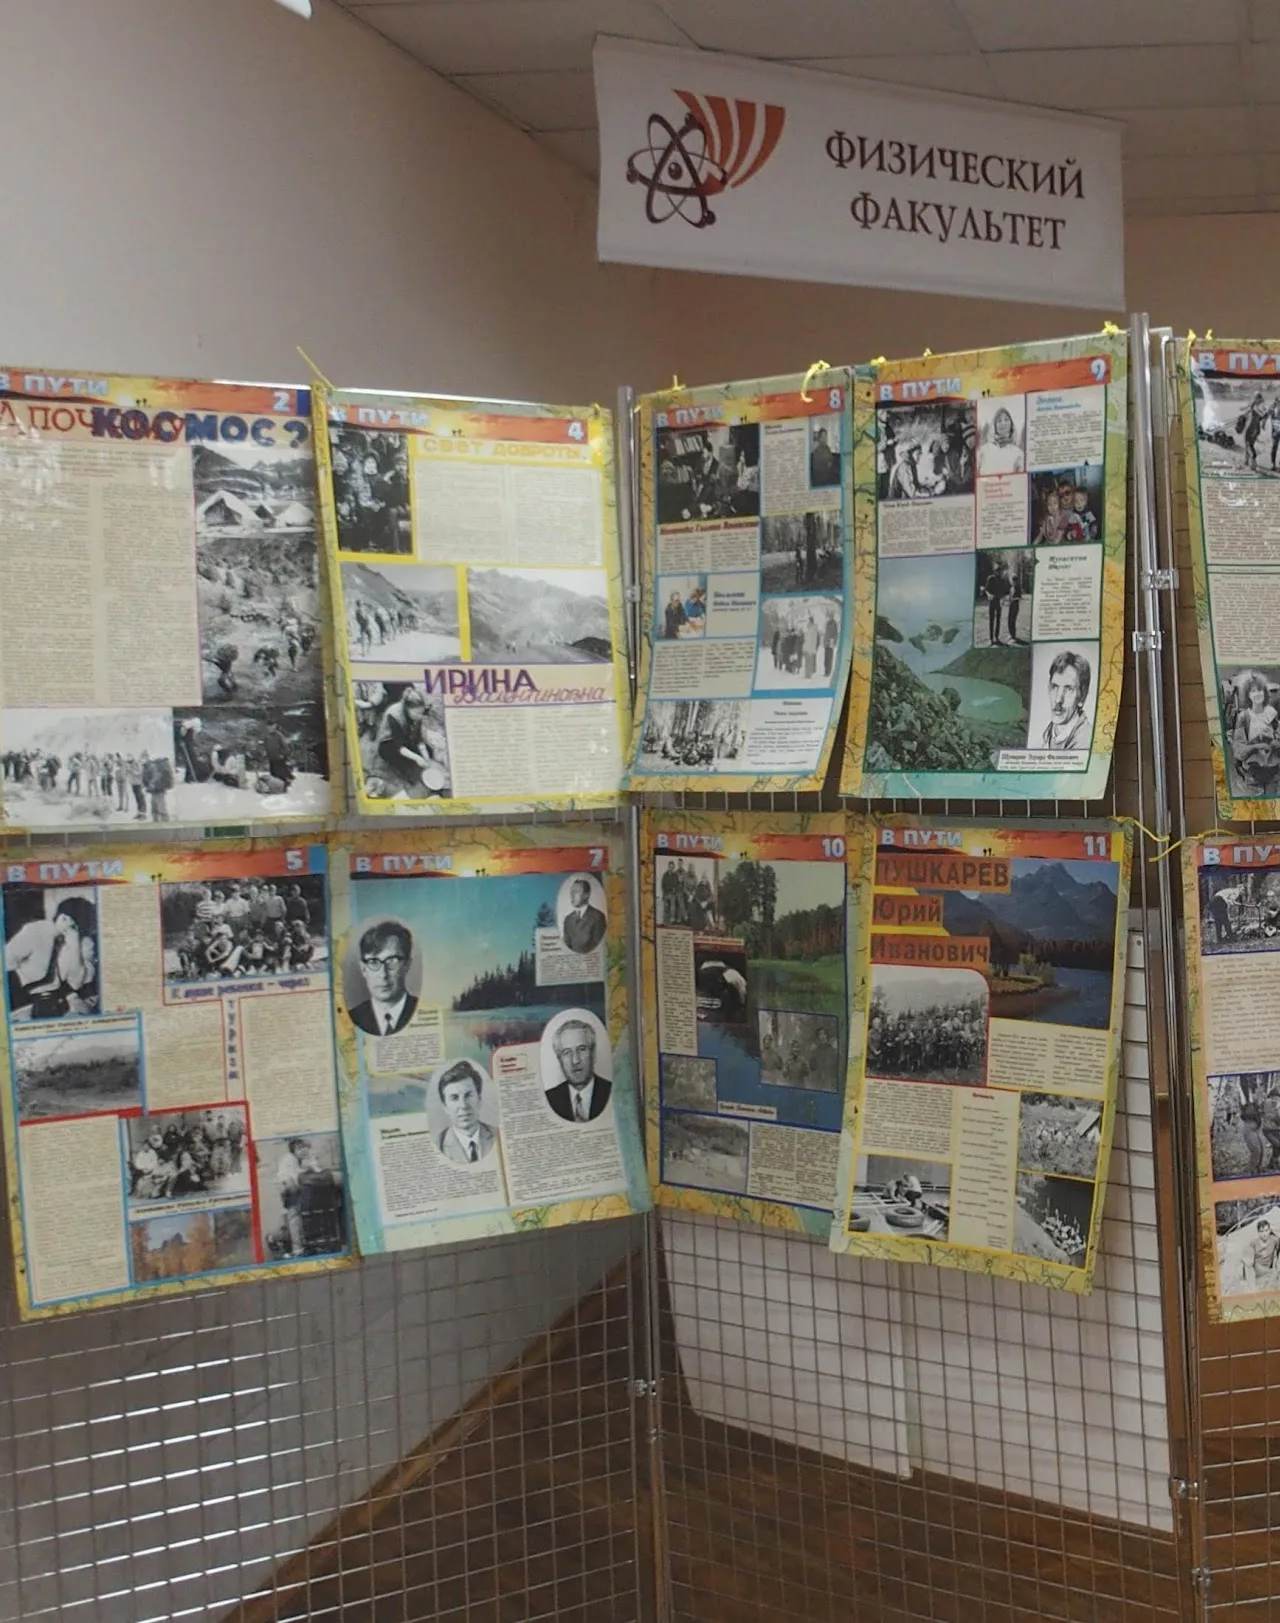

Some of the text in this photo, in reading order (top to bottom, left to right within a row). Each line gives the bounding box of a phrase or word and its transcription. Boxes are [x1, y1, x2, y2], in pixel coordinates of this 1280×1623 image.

[825, 129, 1086, 199] ФИЗИЧЕСКИЙ
[850, 191, 1067, 250] ФАКУЛЬТЕТ
[1199, 353, 1216, 371] В
[24, 374, 109, 397] ПУТИ
[273, 391, 291, 412] 2
[879, 357, 1107, 401] В ПУТИ 9
[657, 388, 841, 428] В ПУТИ 8
[357, 407, 429, 427] ПУТИ
[567, 420, 584, 442] 4
[424, 668, 539, 694] ИРИНА
[656, 833, 845, 858] В ПУТИ 10
[881, 829, 1106, 857] В ПУТИ 11
[1204, 847, 1220, 865] В
[7, 850, 302, 883] В ПУТИ 5
[356, 849, 604, 872] В ПУТИ 7
[877, 860, 1009, 887] ПУШКАРЕВ
[875, 897, 941, 926] Юрий
[871, 936, 989, 963] Иванович
